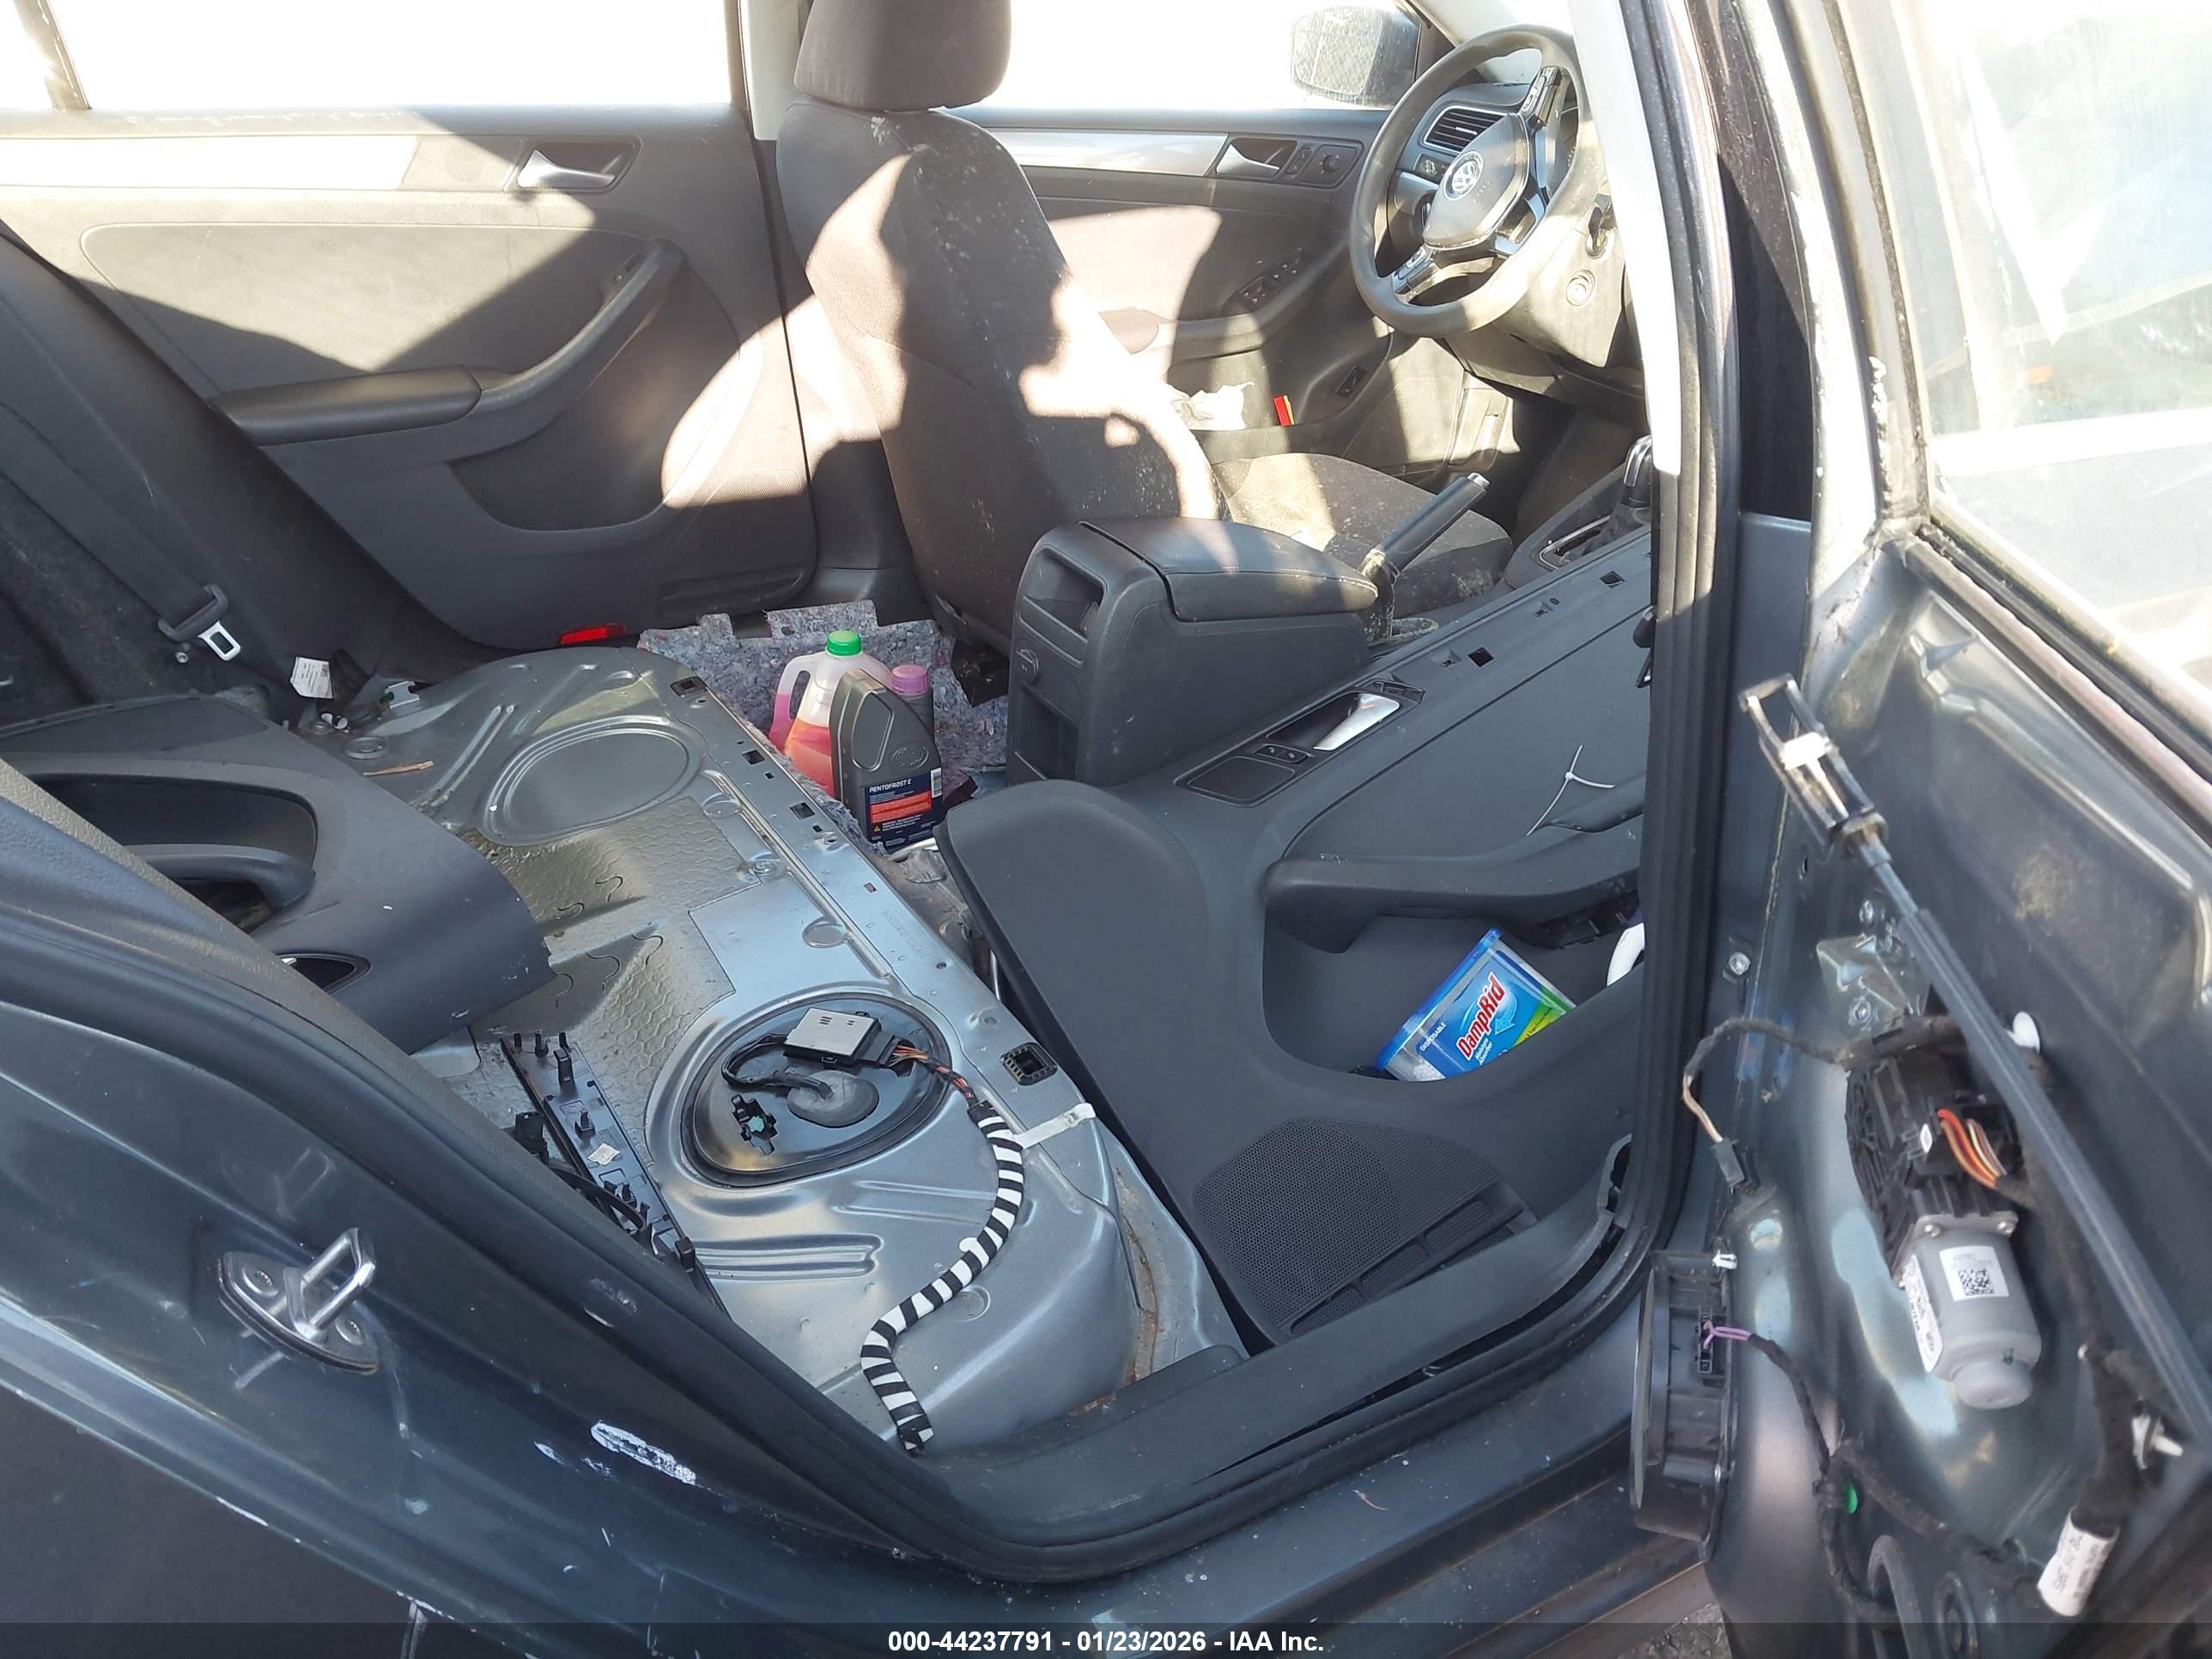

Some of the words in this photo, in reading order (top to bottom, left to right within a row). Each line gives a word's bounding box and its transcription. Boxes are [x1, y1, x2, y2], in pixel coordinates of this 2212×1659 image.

[869, 779, 908, 793] PENTOFROST
[1456, 971, 1505, 1061] DampRid
[1419, 1022, 1447, 1052] DISPOSABLE
[1474, 1037, 1488, 1060] Moisture
[1478, 1041, 1492, 1065] Absorber
